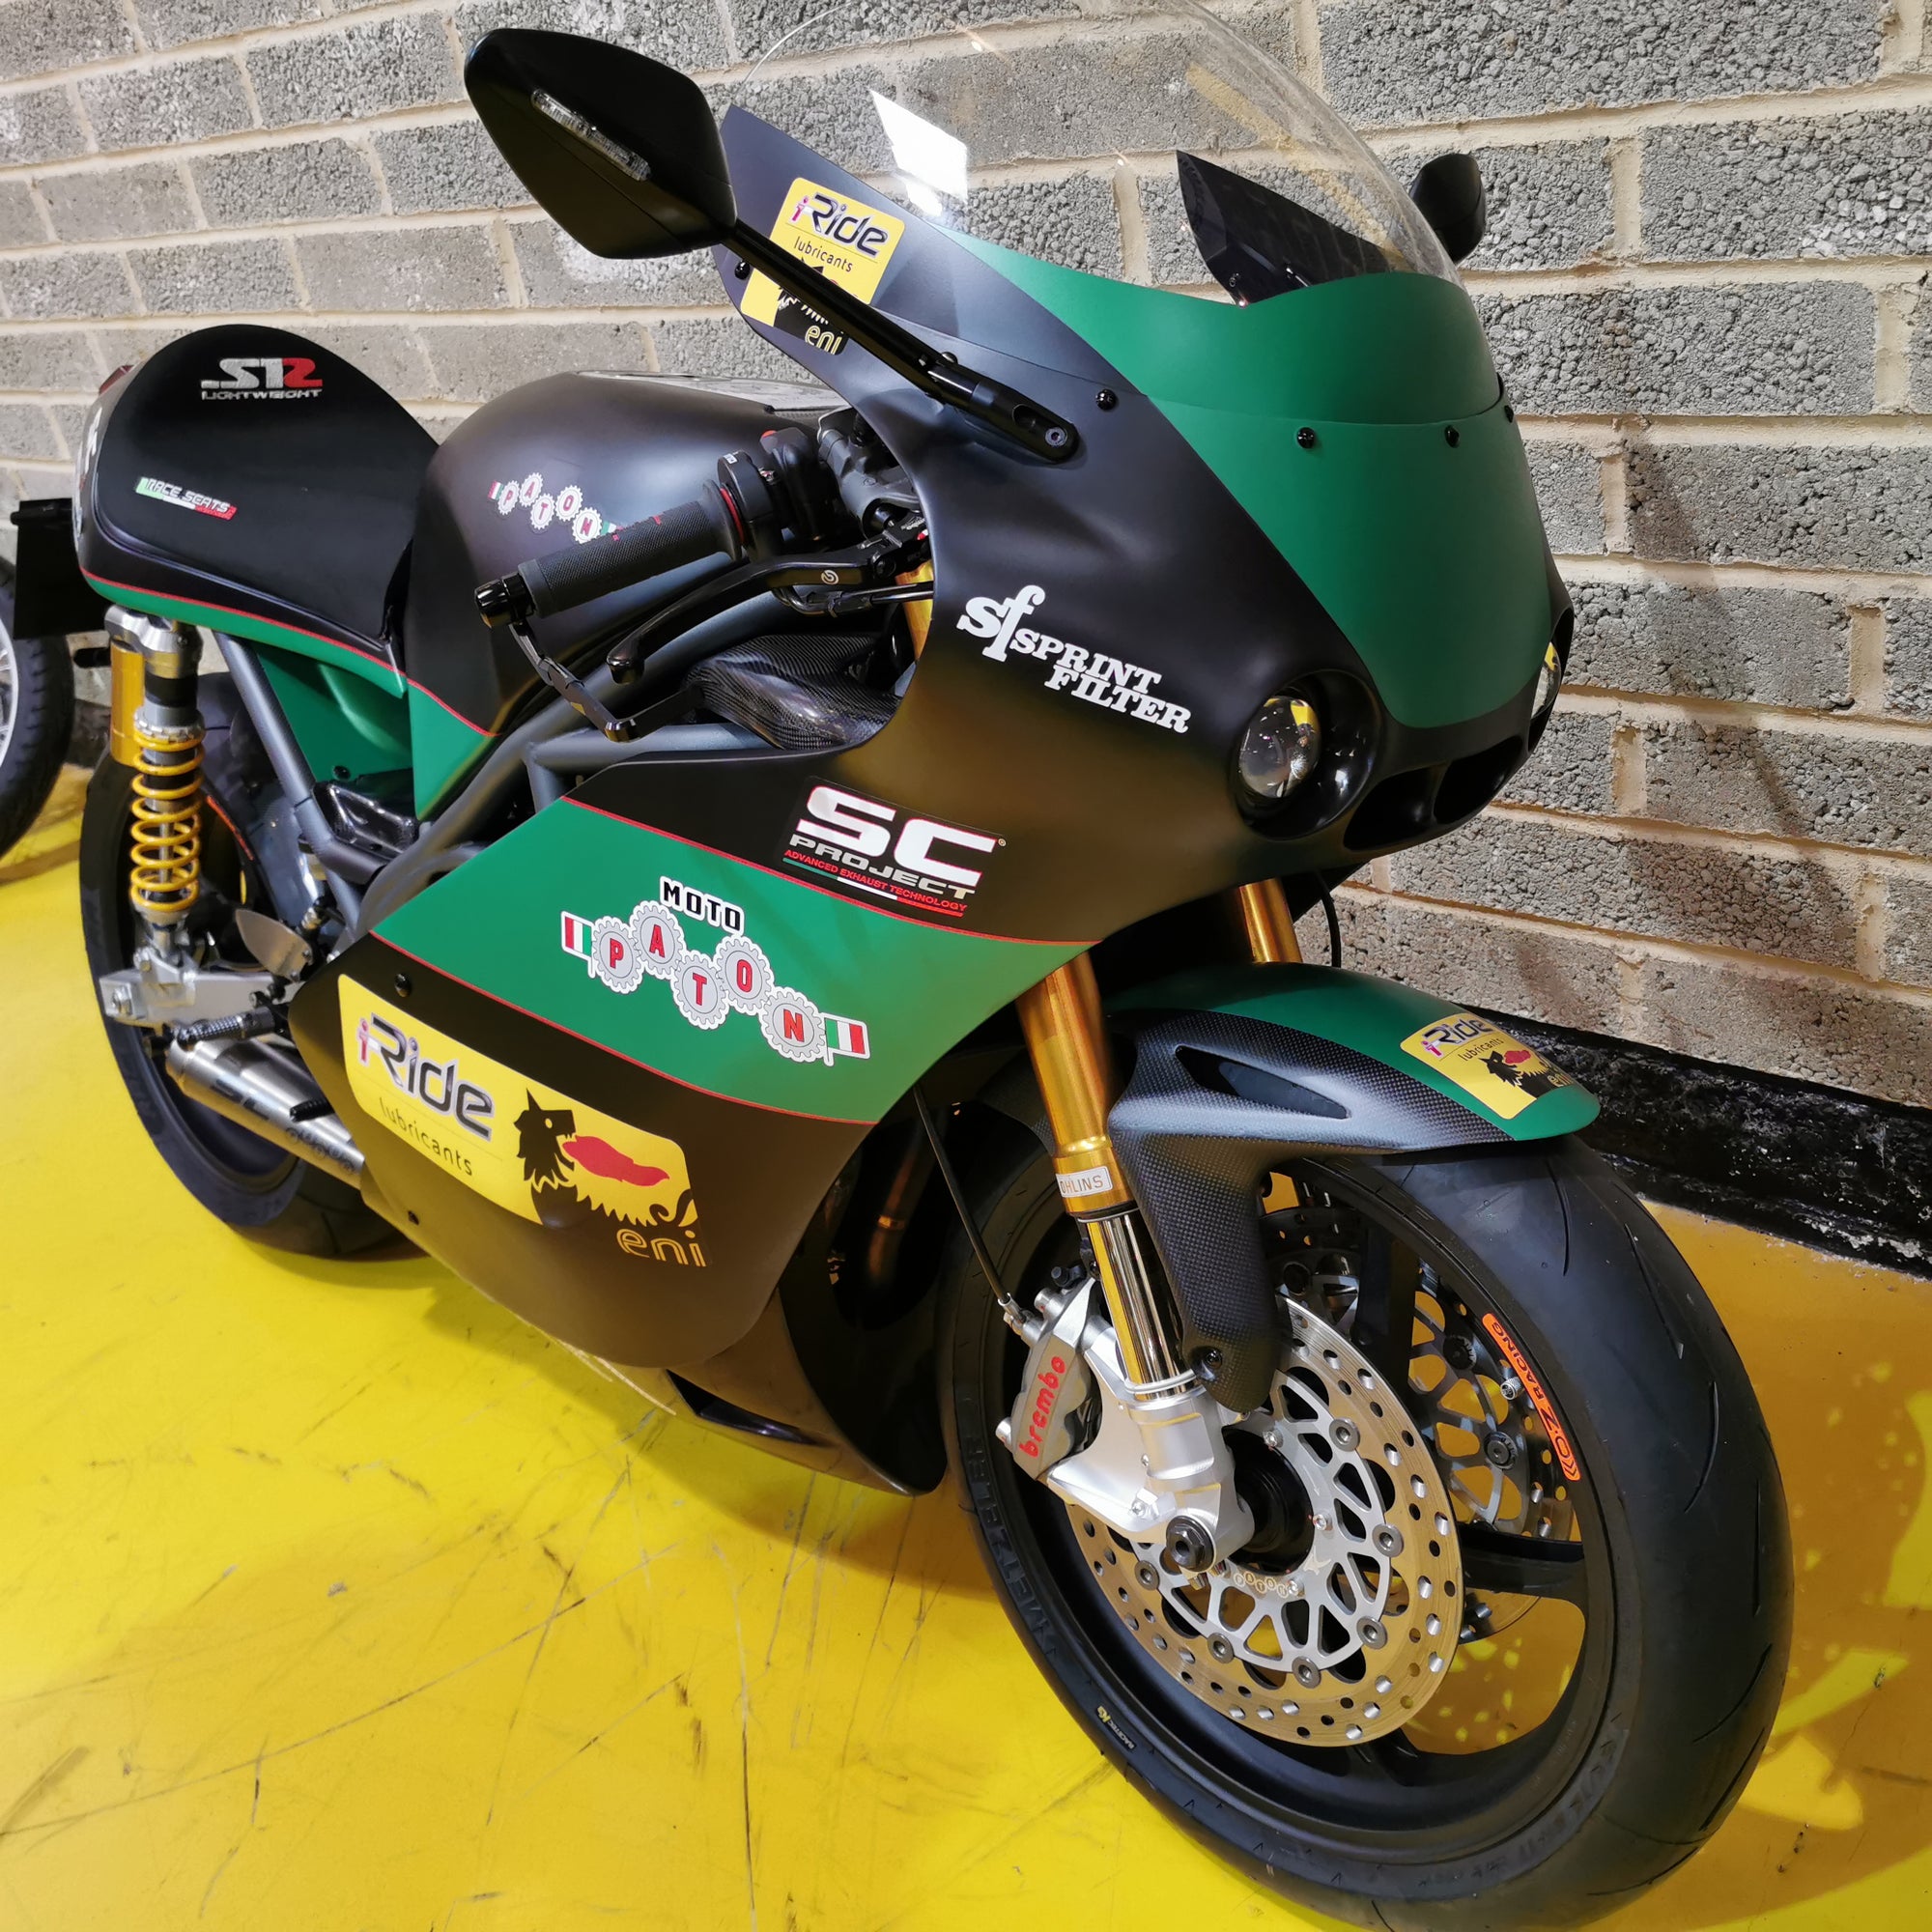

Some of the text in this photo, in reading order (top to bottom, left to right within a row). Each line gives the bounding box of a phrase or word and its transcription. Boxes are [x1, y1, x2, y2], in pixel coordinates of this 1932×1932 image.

[790, 193, 888, 258] iRide
[794, 236, 853, 272] lubricants
[804, 325, 845, 355] eni
[201, 389, 322, 400] LIGHTWEIGHT
[147, 478, 230, 513] RACE SEATS
[502, 480, 594, 537] PATON
[1009, 628, 1162, 695] SPRINT
[1044, 664, 1192, 734] FILTER
[789, 834, 976, 900] PROJECT
[796, 785, 998, 887] SC
[663, 880, 741, 932] MOTO
[784, 849, 967, 912] ADVANCED EXHAUST TECHNOLOGY
[606, 921, 810, 1046] PATON
[1421, 1018, 1494, 1059] iRide
[1458, 1037, 1504, 1062] lubricants
[355, 1012, 496, 1142] iRide
[379, 1097, 473, 1178] lubricants
[616, 1228, 707, 1267] eni
[1492, 1321, 1544, 1401] RACING
[1019, 1356, 1065, 1459] brembo
